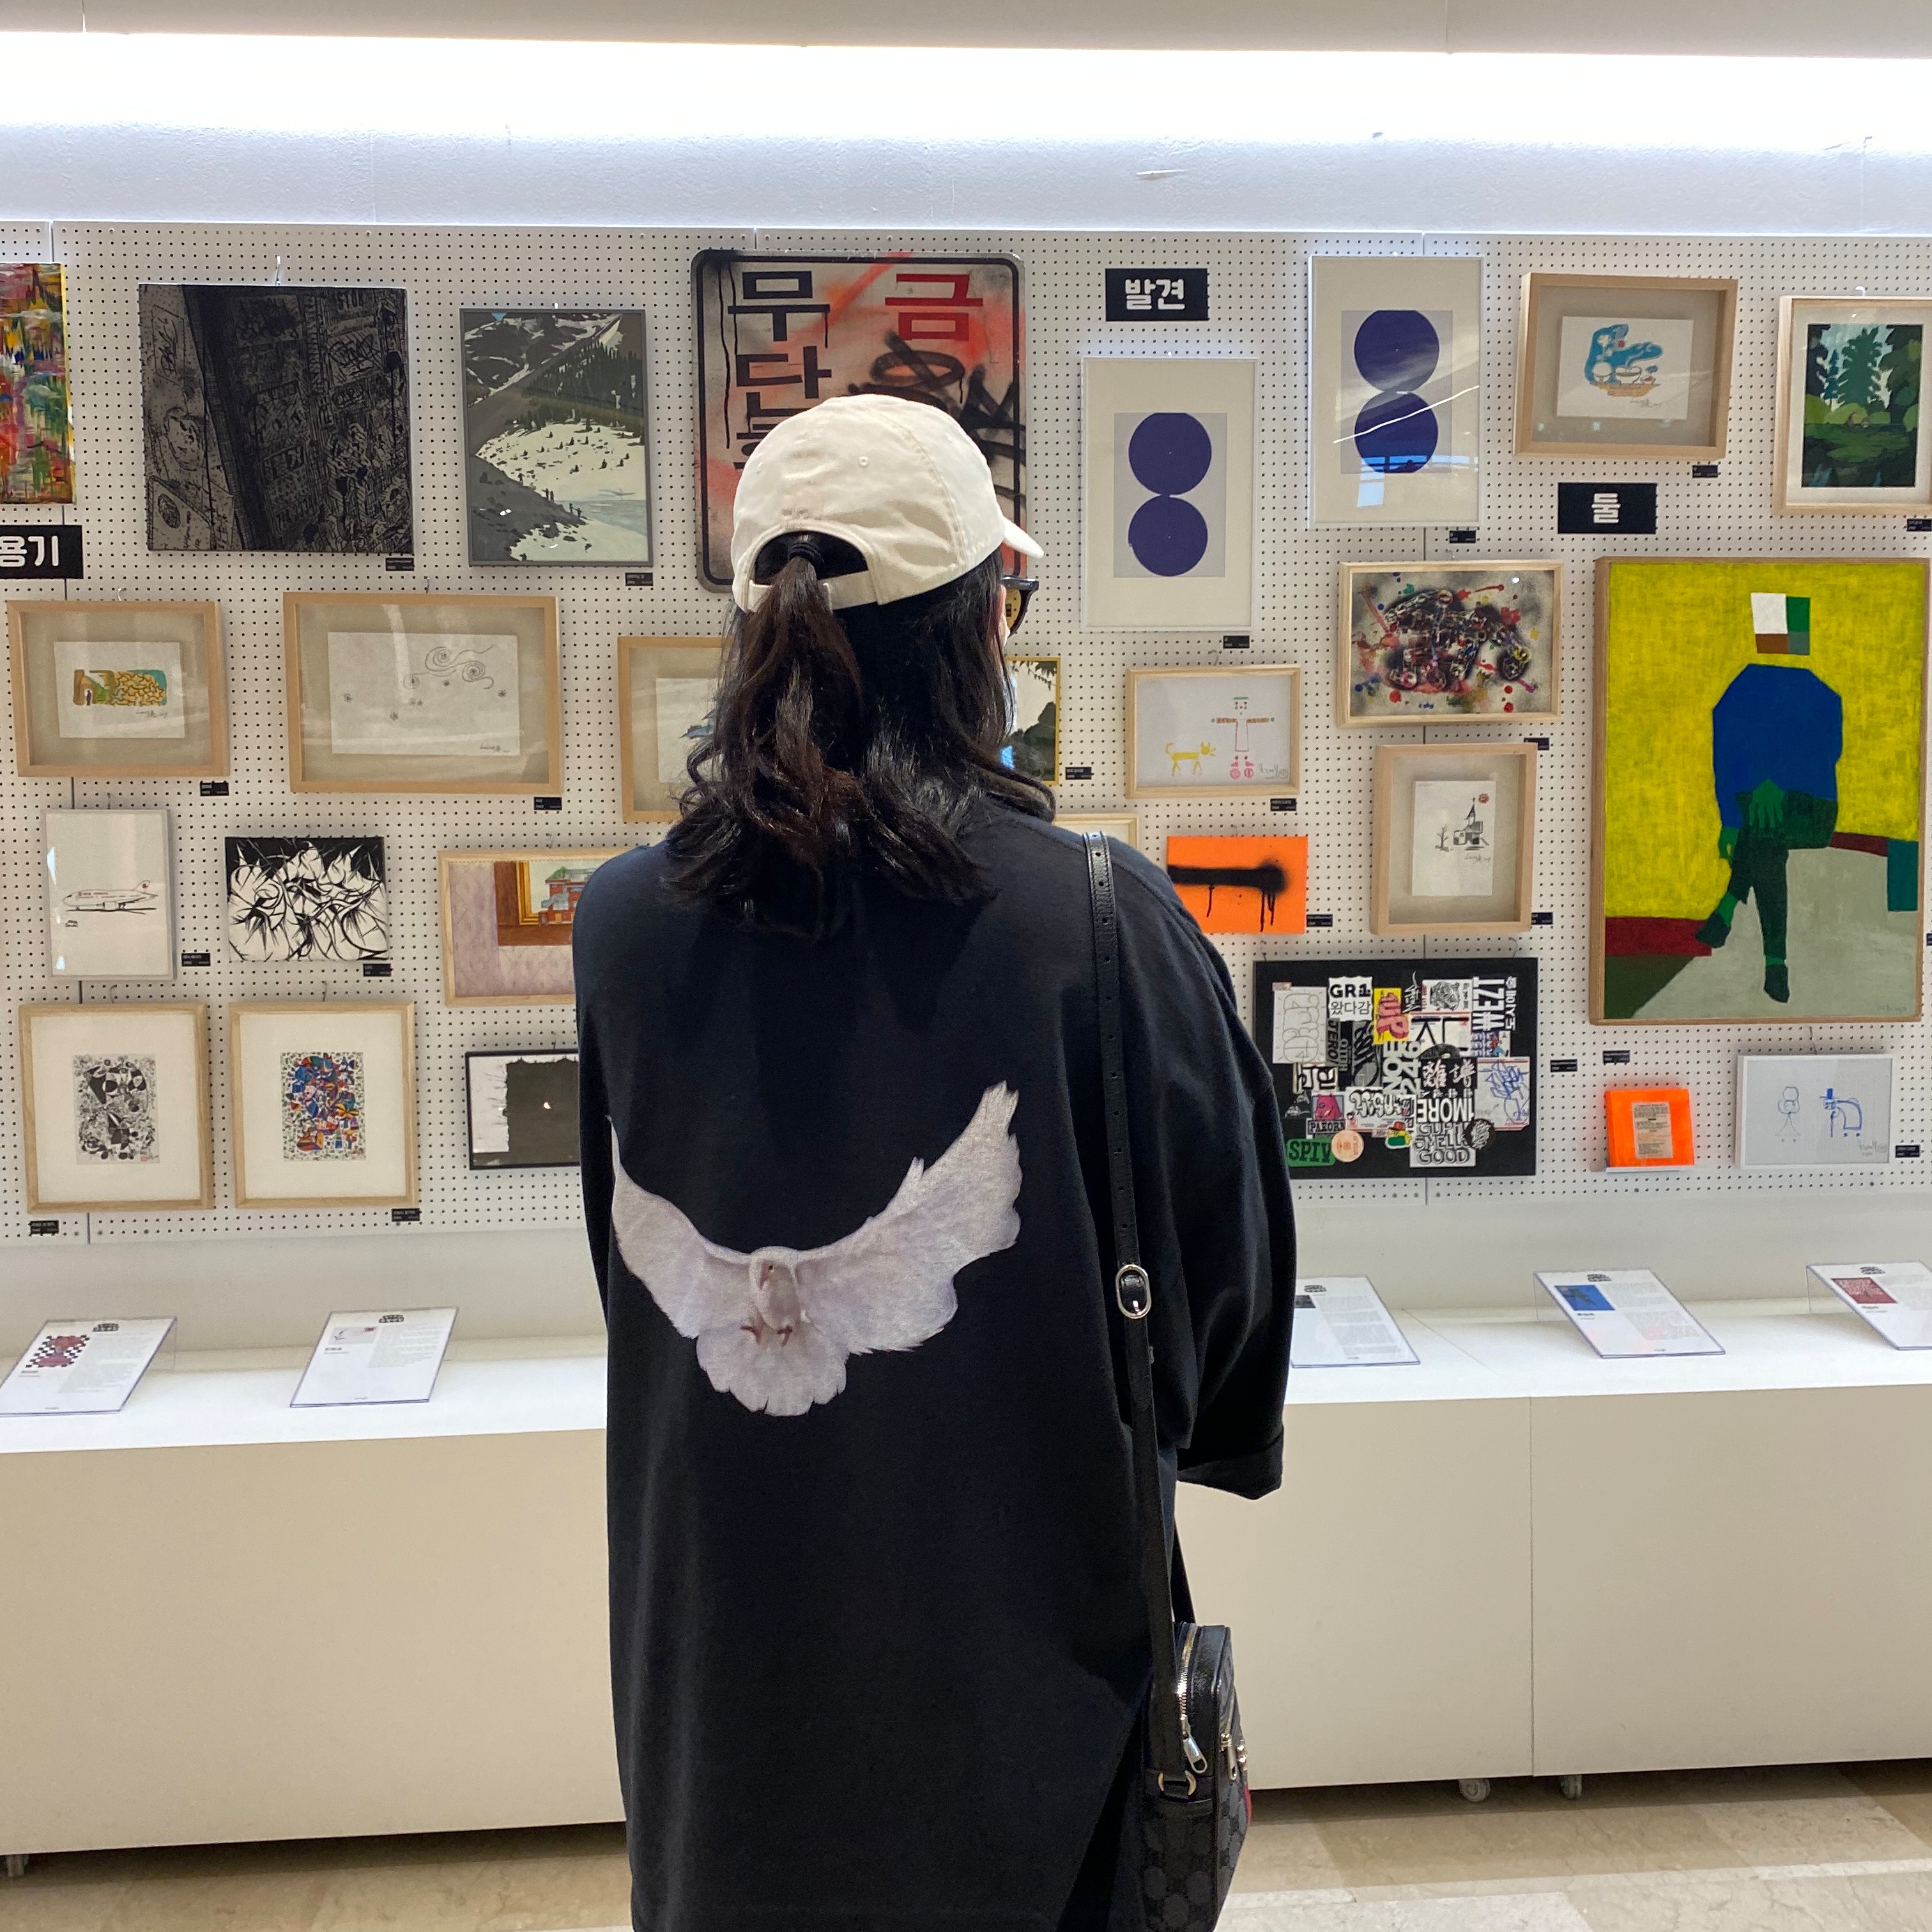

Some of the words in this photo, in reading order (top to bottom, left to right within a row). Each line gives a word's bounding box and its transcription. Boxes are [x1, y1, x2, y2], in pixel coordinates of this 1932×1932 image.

[1125, 279, 1186, 310] 발견
[1591, 493, 1621, 524] 둘
[0, 535, 59, 567] 용기
[1330, 983, 1371, 998] GR1
[1330, 1001, 1371, 1015] 왔다감
[1416, 1150, 1469, 1165] GOOD
